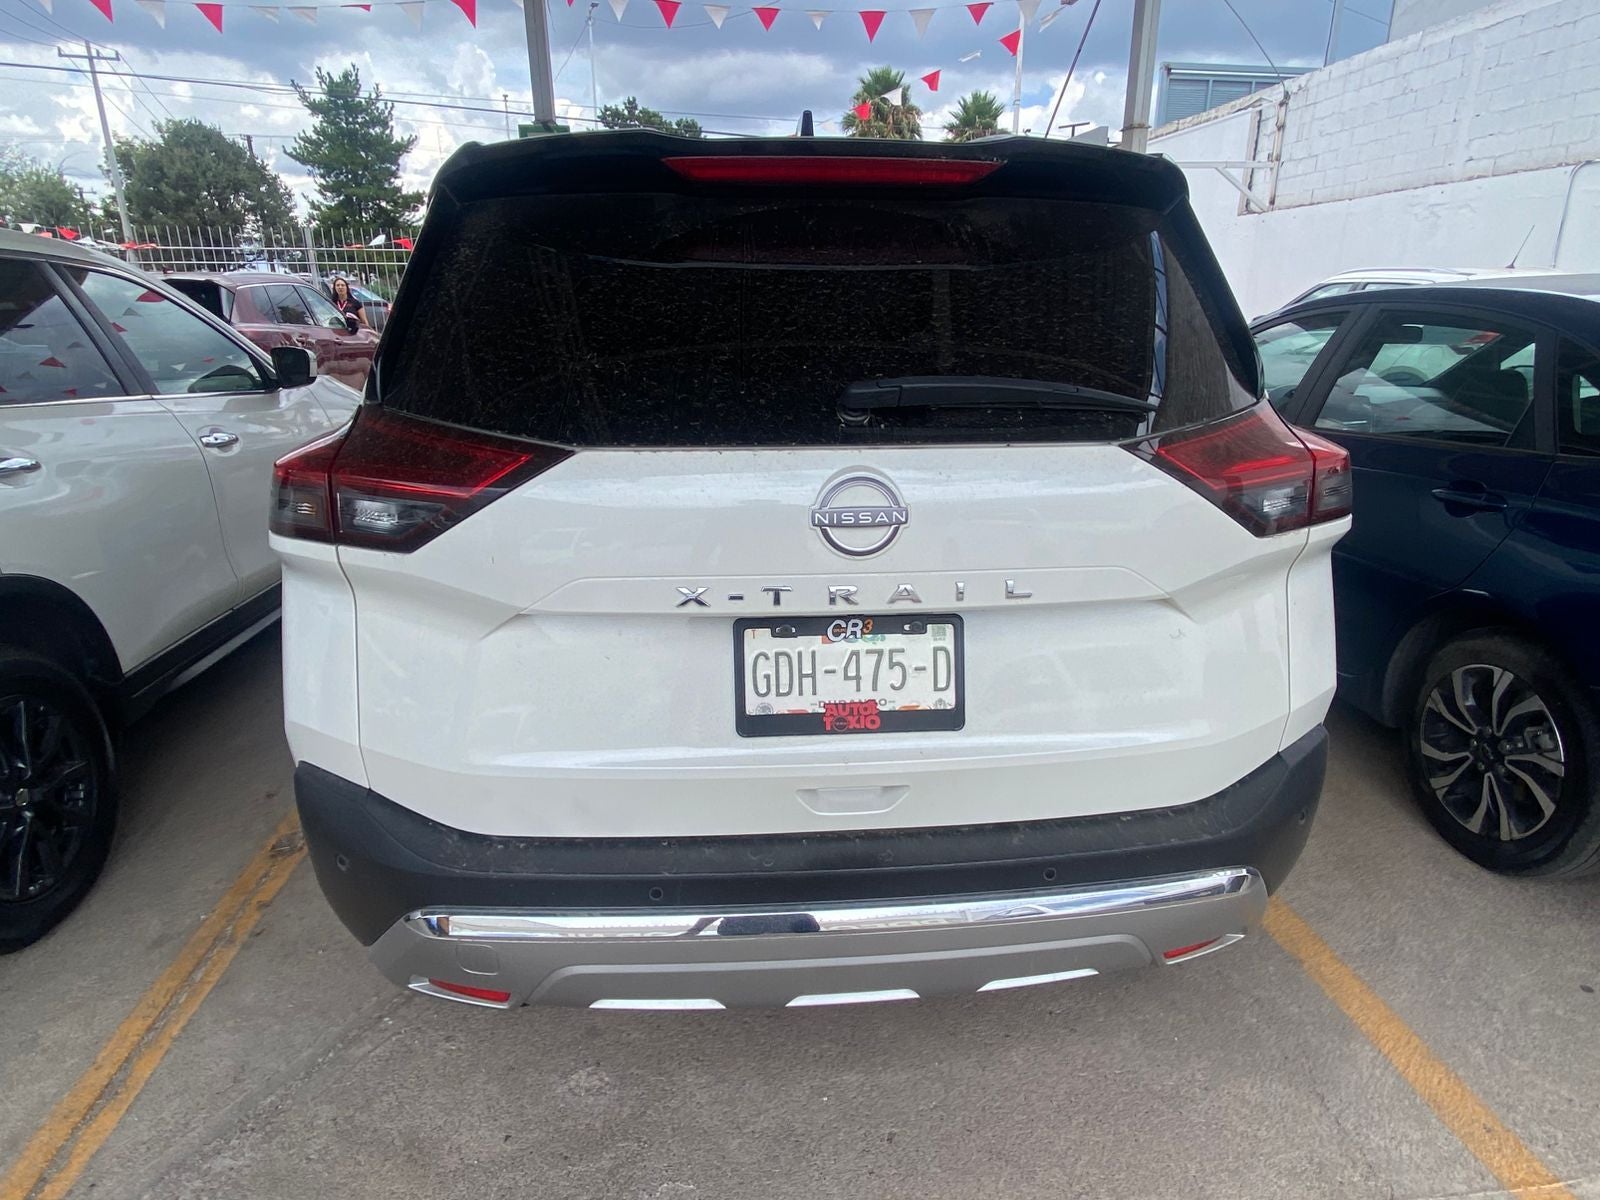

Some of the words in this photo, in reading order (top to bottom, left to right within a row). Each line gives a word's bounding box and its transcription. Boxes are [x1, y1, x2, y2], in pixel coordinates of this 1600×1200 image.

[814, 510, 906, 525] NISSAN
[675, 578, 1033, 608] X-TRAIL
[752, 646, 952, 698] GDH-475-D
